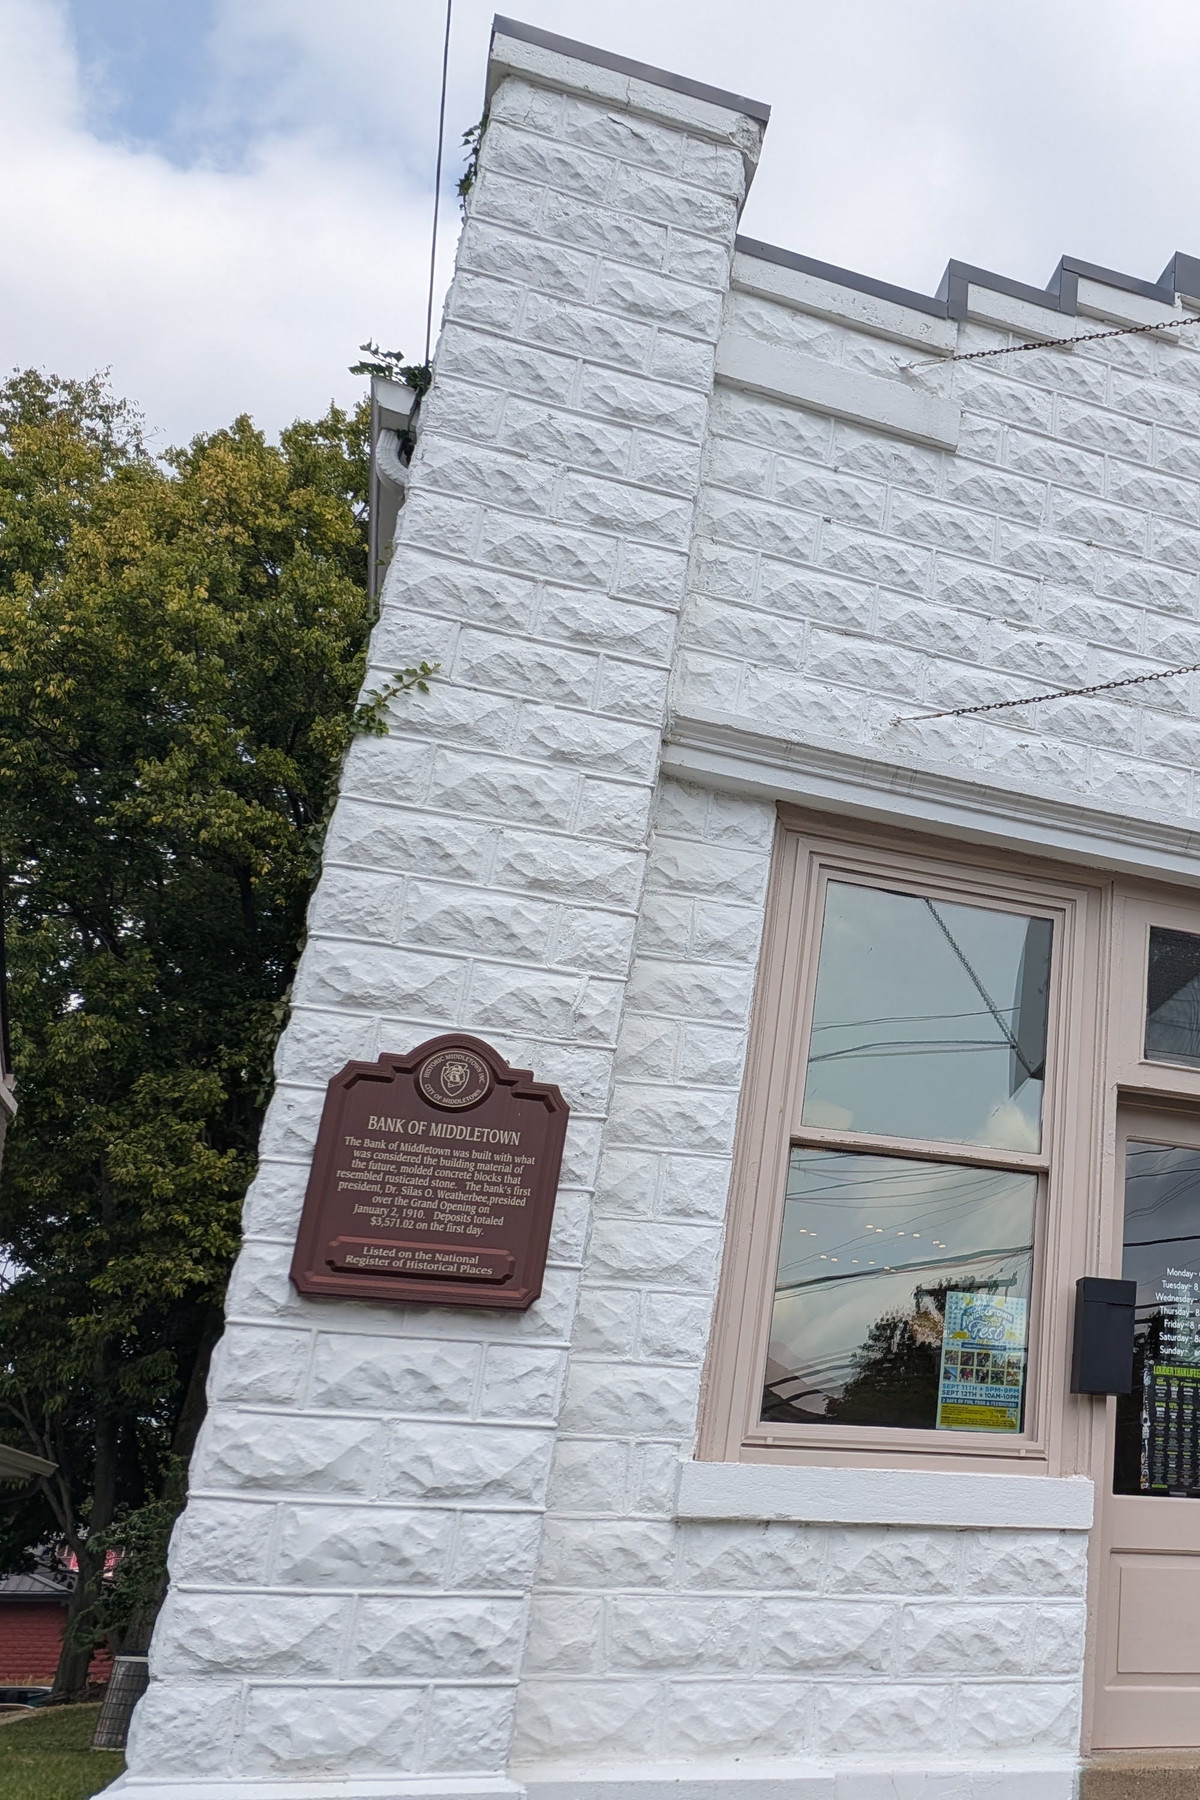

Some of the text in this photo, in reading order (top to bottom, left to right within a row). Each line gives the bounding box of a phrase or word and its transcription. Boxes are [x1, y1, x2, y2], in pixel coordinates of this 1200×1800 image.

[424, 1055, 445, 1078] HISTORIC
[445, 1053, 483, 1074] MIDDLETOWN
[424, 1083, 482, 1105] CITY OF MIDDLETOWN
[367, 1115, 521, 1146] BANK OF MIDDLETOWN
[344, 1136, 536, 1165] The Bank of Middletown was built with what
[351, 1159, 521, 1185] the future, molded concrete blocks that
[353, 1150, 525, 1175] was considered the building material of
[336, 1170, 531, 1196] resembled rusticated stone. The bank's first
[337, 1181, 383, 1194] president,
[385, 1184, 399, 1194] Dr.
[400, 1185, 423, 1196] Silas
[424, 1188, 435, 1198] O.
[352, 1203, 504, 1226] January 2, 1910. Deposits totaled
[371, 1195, 490, 1215] over the Grand Opening on
[370, 1216, 485, 1238] $3,571.02 on the first day.
[345, 1254, 493, 1276] Register of Historical Places
[362, 1246, 480, 1265] Listed on the National
[968, 1319, 1004, 1340] Fest
[984, 1392, 1019, 1400] 10AM-10PM
[985, 1386, 1020, 1394] 5PM-9PM
